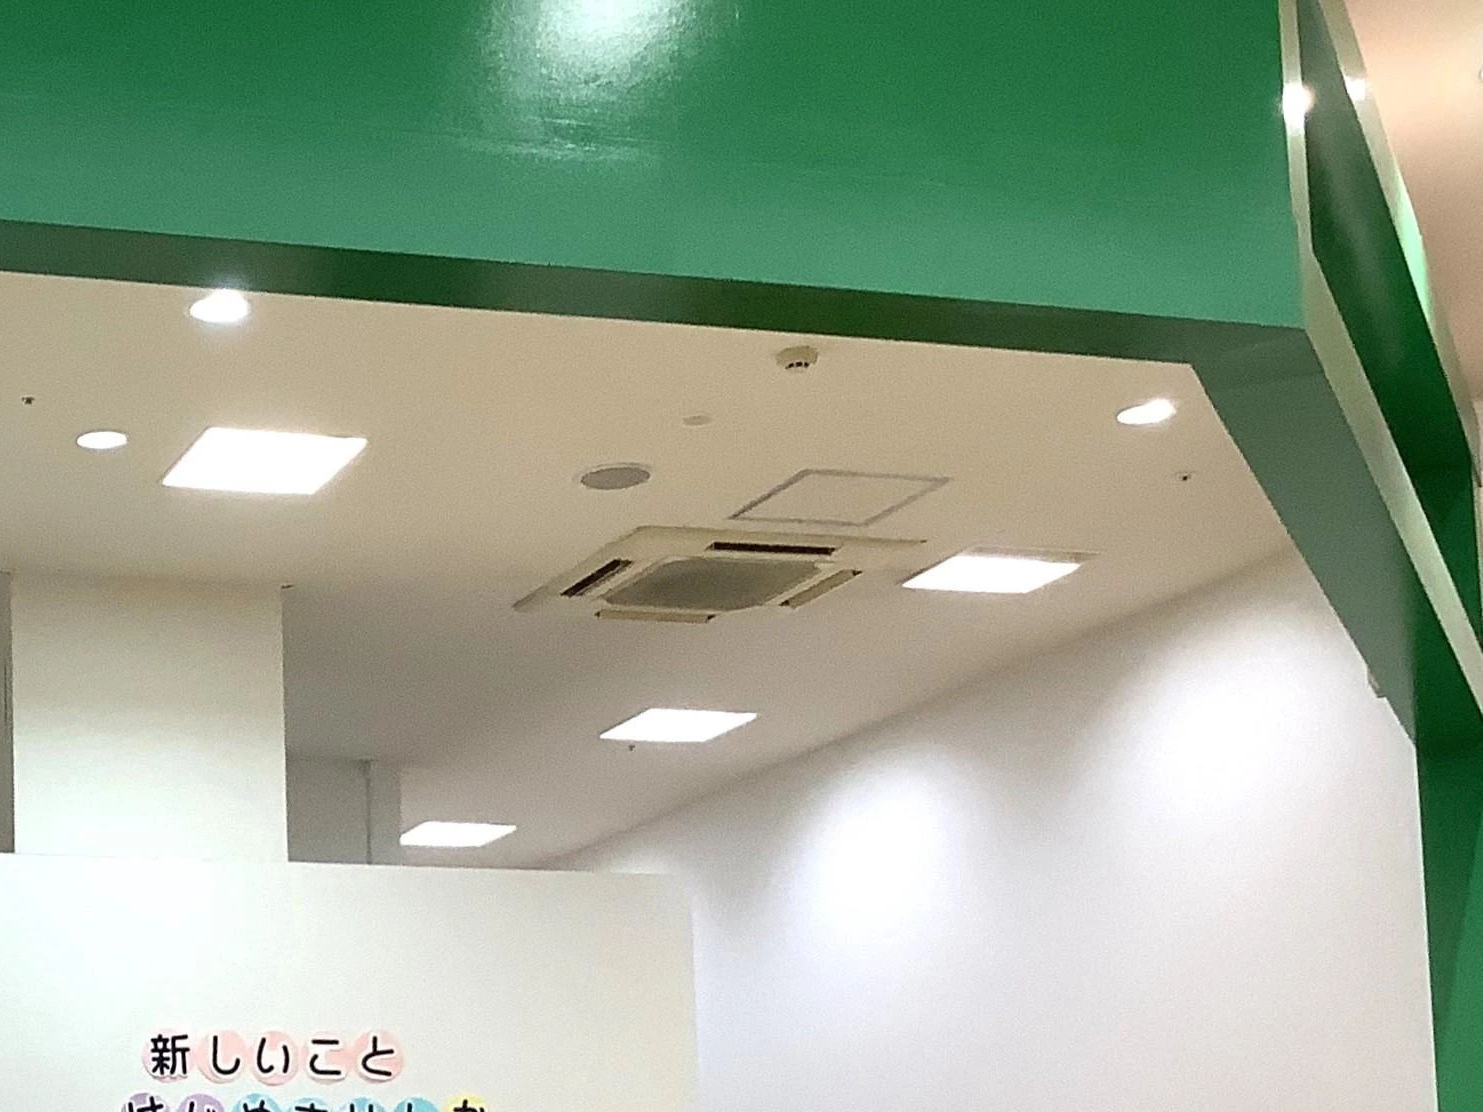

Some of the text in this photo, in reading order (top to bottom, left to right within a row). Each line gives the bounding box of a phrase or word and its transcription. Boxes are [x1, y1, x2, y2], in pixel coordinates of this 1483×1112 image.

[150, 1033, 395, 1077] 新しいこと
